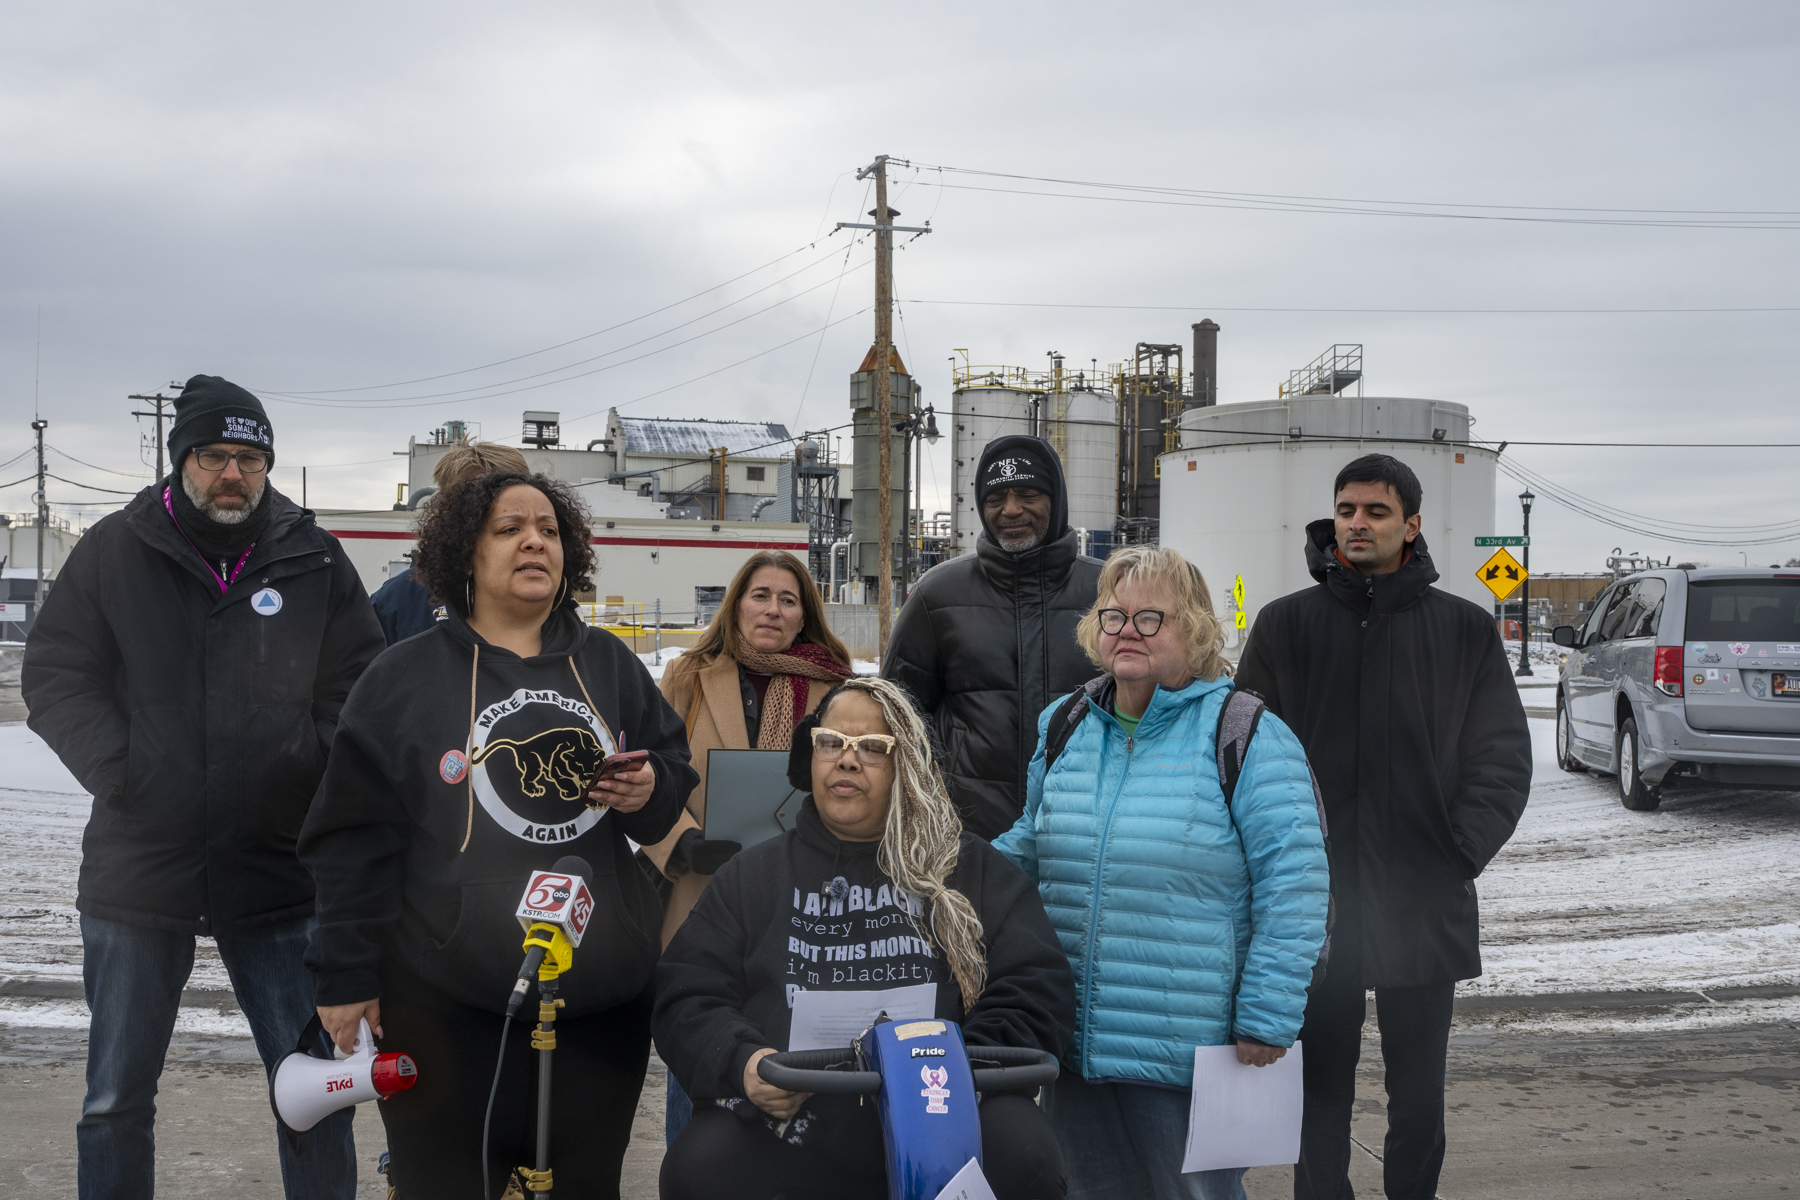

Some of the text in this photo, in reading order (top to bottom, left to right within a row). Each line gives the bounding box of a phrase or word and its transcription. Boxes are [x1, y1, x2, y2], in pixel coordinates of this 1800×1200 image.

[224, 416, 257, 428] WE OUR
[227, 423, 254, 434] SOMALI
[222, 430, 258, 442] NEIGHBORS
[998, 458, 1018, 468] NFL
[478, 690, 594, 729] MAKE AMERICA
[443, 759, 462, 779] ICE!
[522, 823, 578, 842] AGAIN
[527, 877, 570, 908] 5 abc
[793, 886, 800, 910] I
[522, 908, 561, 920] KSTP.COM
[573, 897, 590, 926] 45
[791, 915, 853, 938] every
[788, 935, 933, 963] BUT THIS MONTH
[786, 958, 933, 985] i'm blackity
[911, 1046, 946, 1058] Pride
[326, 1078, 354, 1093] PYLE
[922, 1089, 949, 1097] STRONGER
[929, 1096, 944, 1104] THAN
[927, 1105, 948, 1113] CANCER
